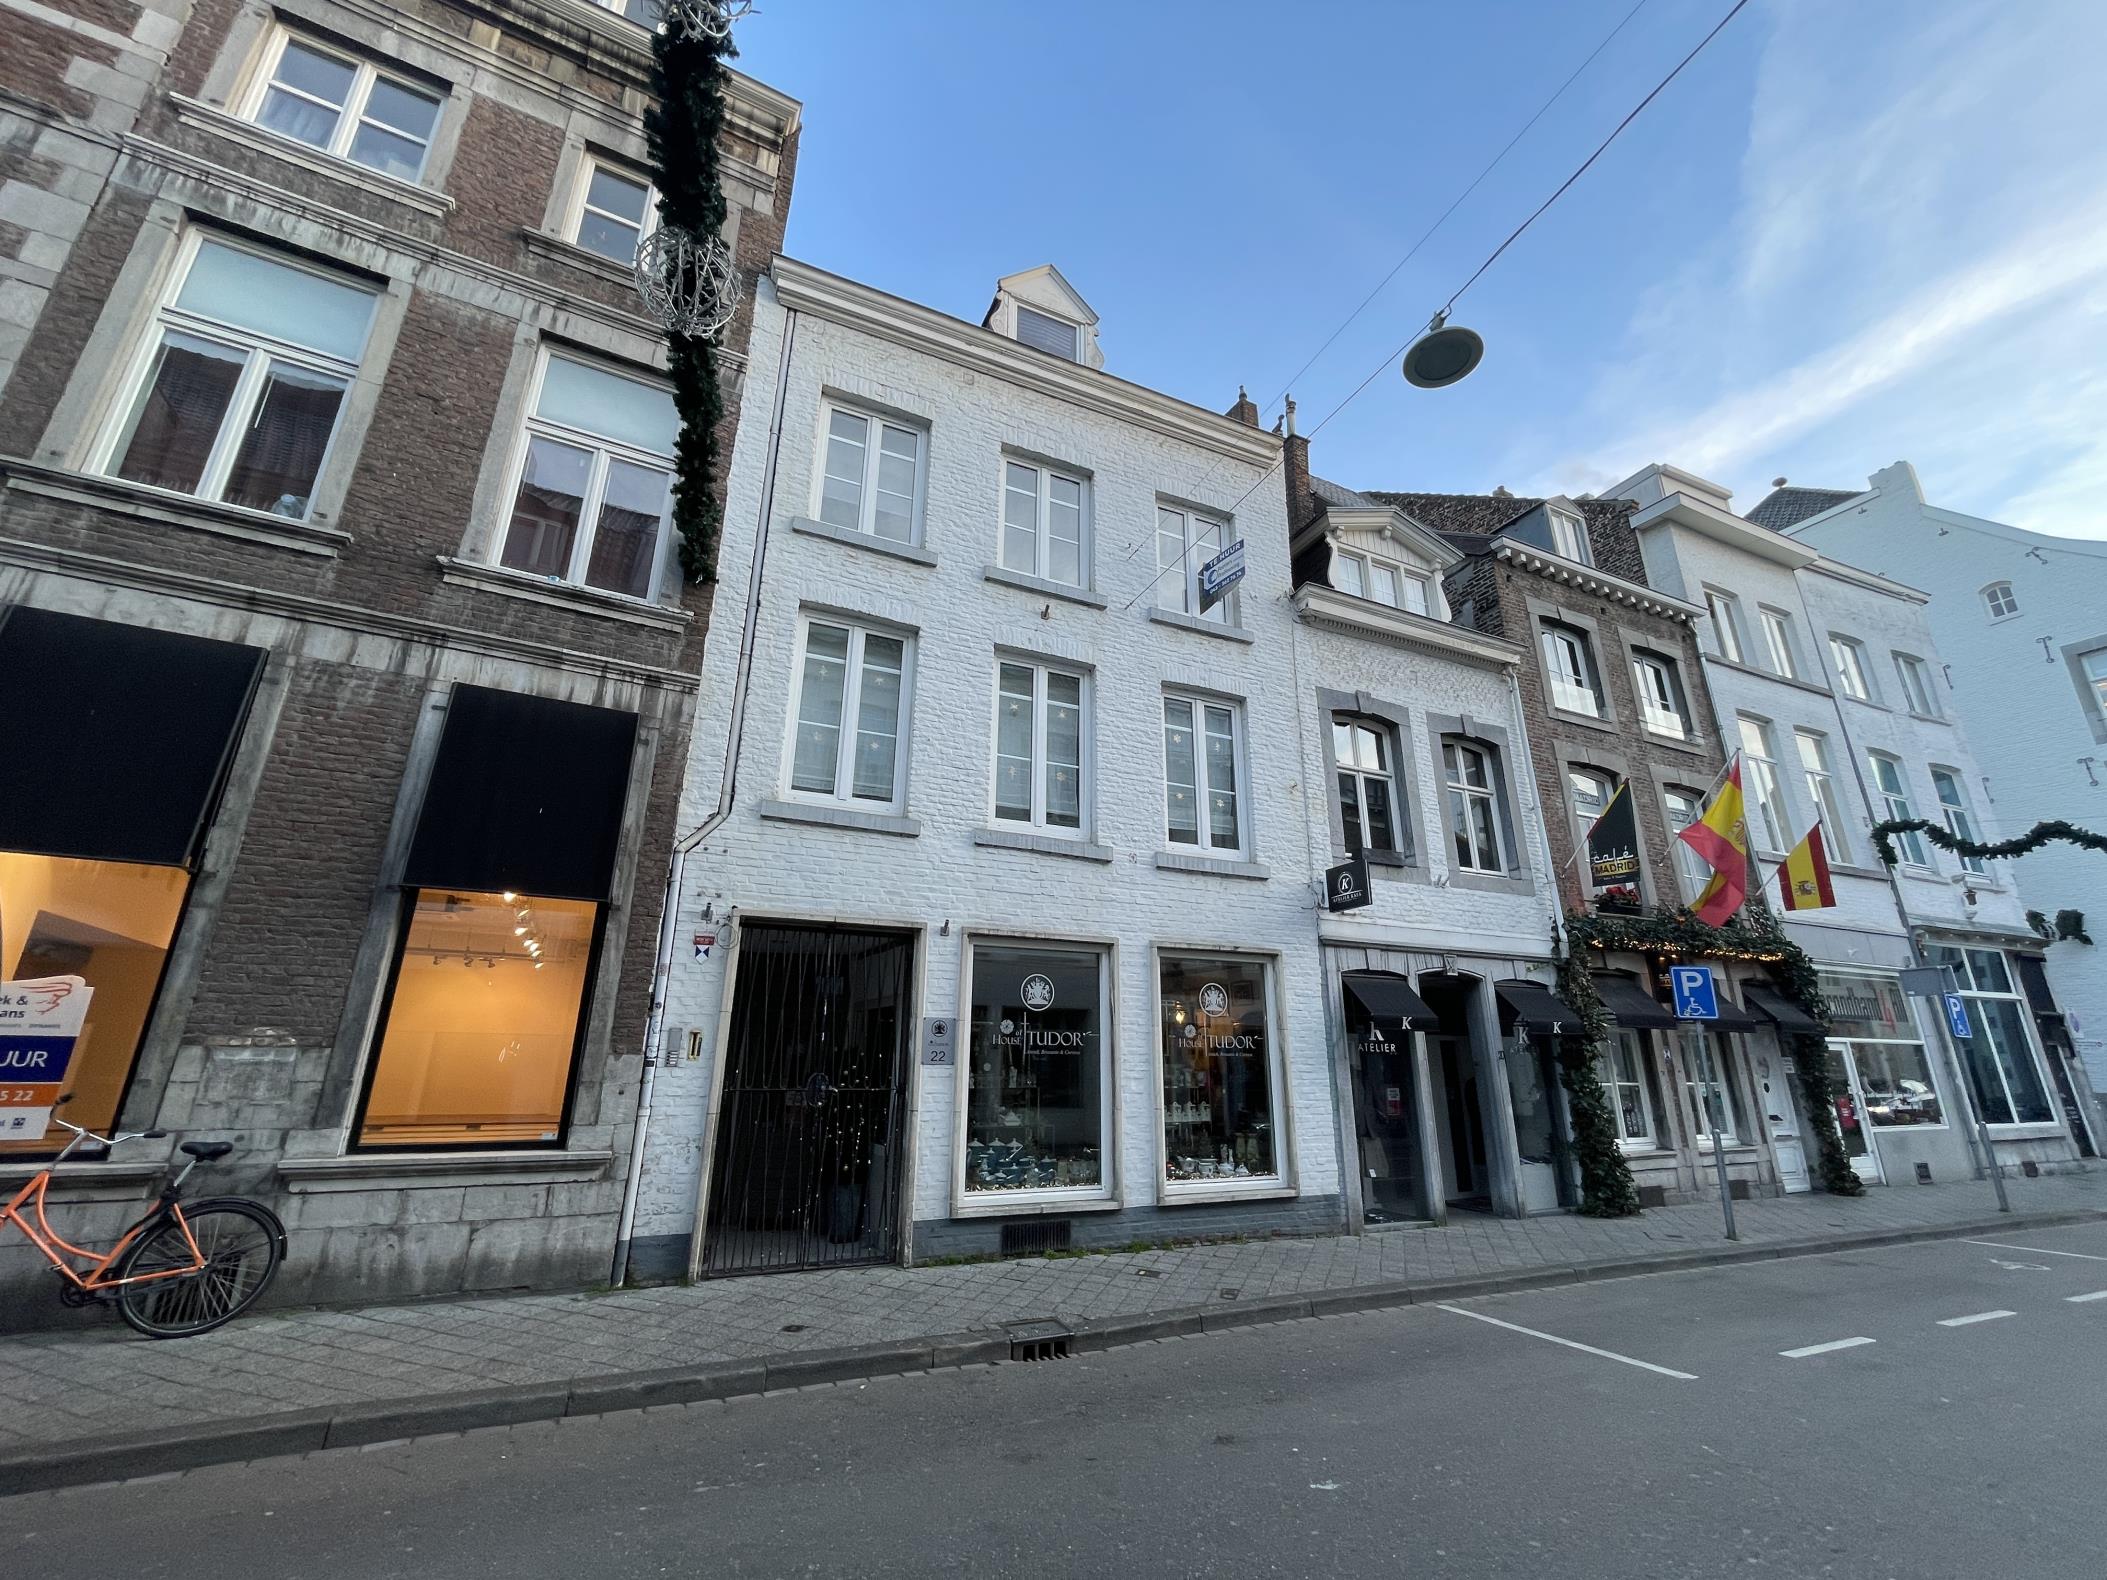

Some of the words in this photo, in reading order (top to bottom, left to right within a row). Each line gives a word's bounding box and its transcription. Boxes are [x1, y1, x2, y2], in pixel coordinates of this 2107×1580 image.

[1219, 542, 1241, 561] HUUR
[1594, 861, 1635, 875] MADRID
[1341, 877, 1350, 890] K
[1680, 971, 1704, 997] P
[16, 995, 28, 1006] &
[1949, 997, 1961, 1020] P
[1401, 1016, 1413, 1030] K
[1552, 1021, 1563, 1034] K
[1027, 1031, 1084, 1047] TUDOR
[1207, 1035, 1257, 1049] TUDOR
[1358, 1043, 1397, 1053] ATELIER
[930, 1050, 946, 1062] 22
[13, 1090, 34, 1102] 22
